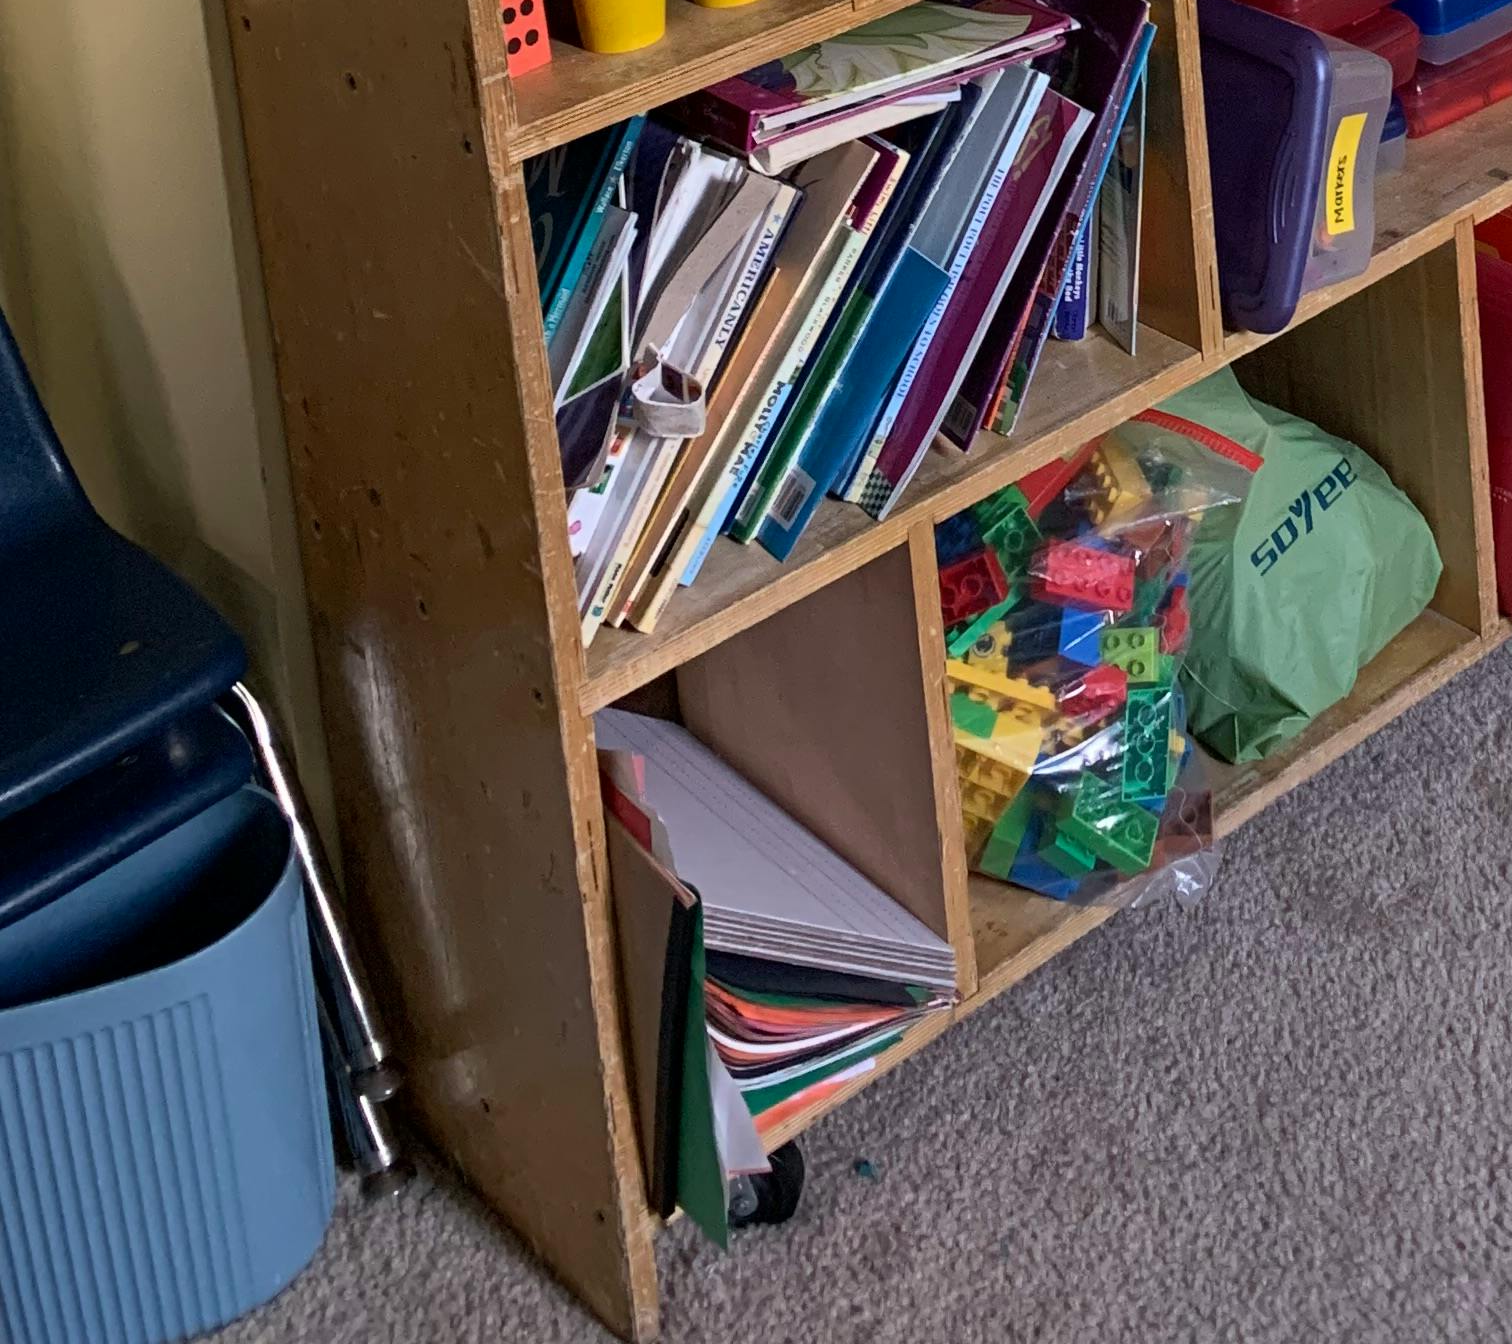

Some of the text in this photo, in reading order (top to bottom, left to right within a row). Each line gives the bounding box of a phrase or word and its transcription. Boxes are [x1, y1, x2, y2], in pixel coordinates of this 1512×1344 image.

[1334, 153, 1350, 224] Markers
[714, 226, 776, 349] AMERICANLY
[896, 351, 924, 399] SCHOOL
[728, 380, 786, 476] MOLLY MAE
